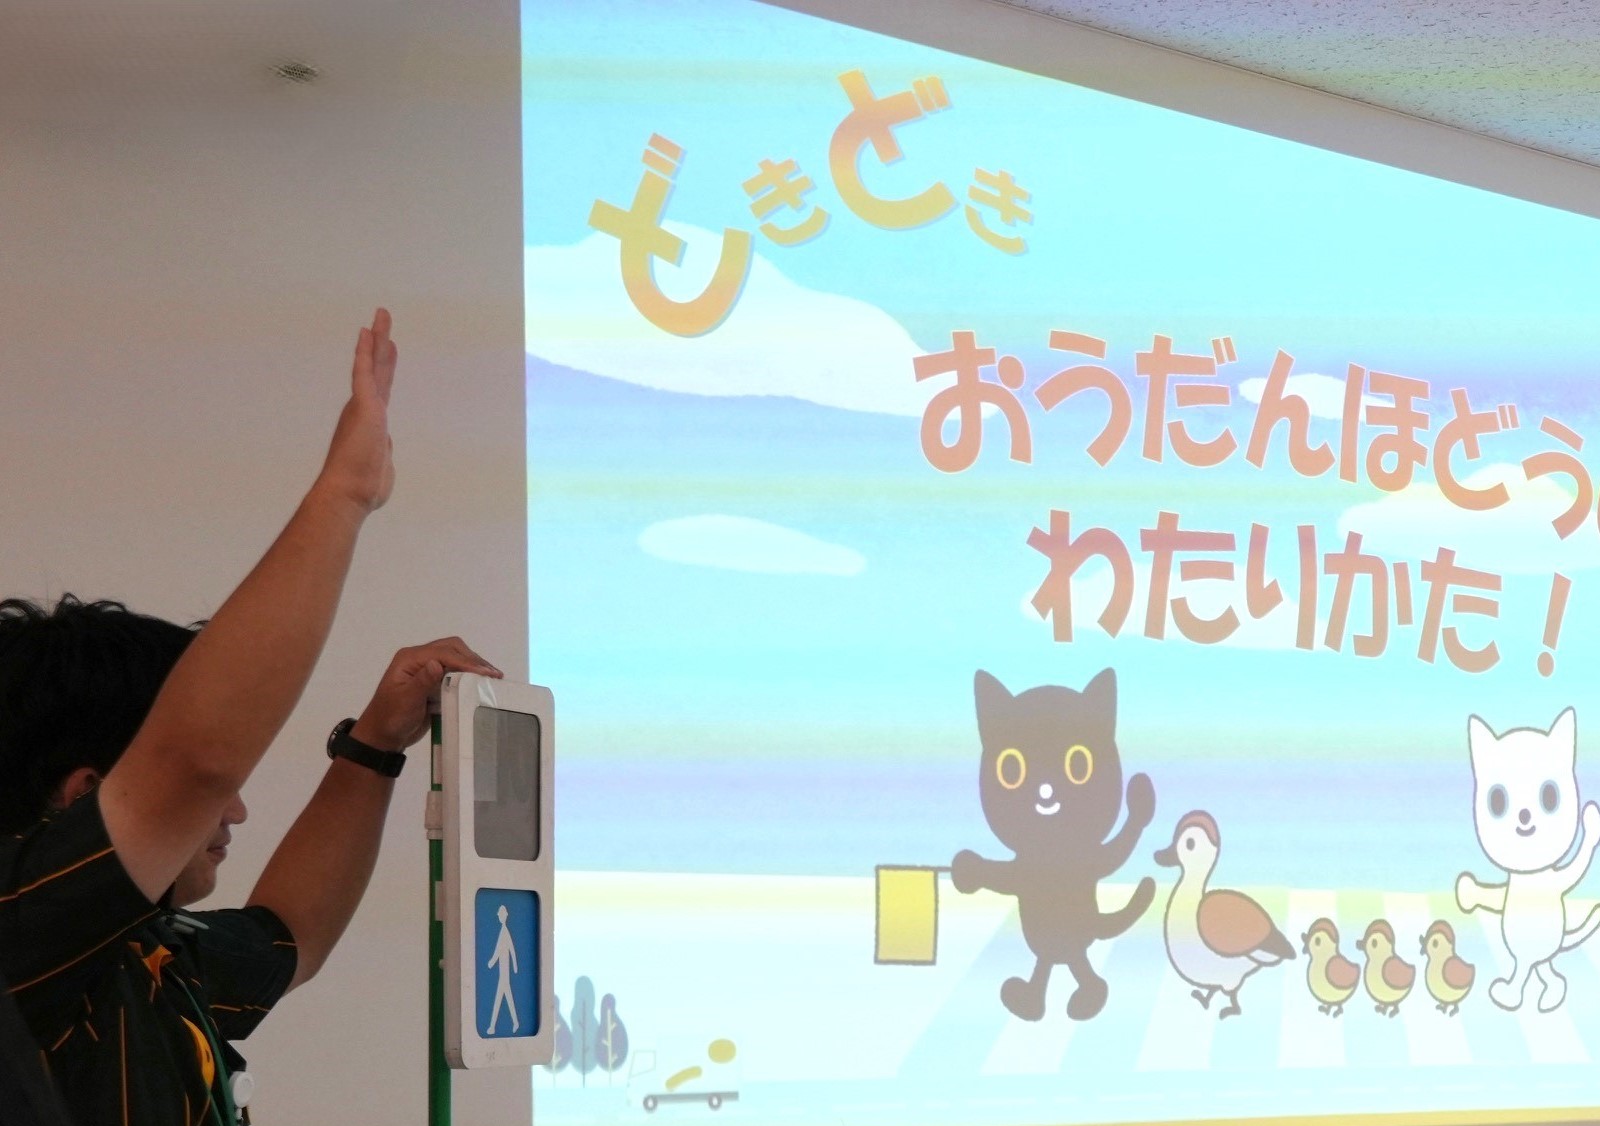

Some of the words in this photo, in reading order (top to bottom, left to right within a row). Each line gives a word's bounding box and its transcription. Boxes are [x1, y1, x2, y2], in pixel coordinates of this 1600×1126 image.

[587, 68, 1033, 339] どきどき
[1025, 508, 1573, 678] わたりかた！
